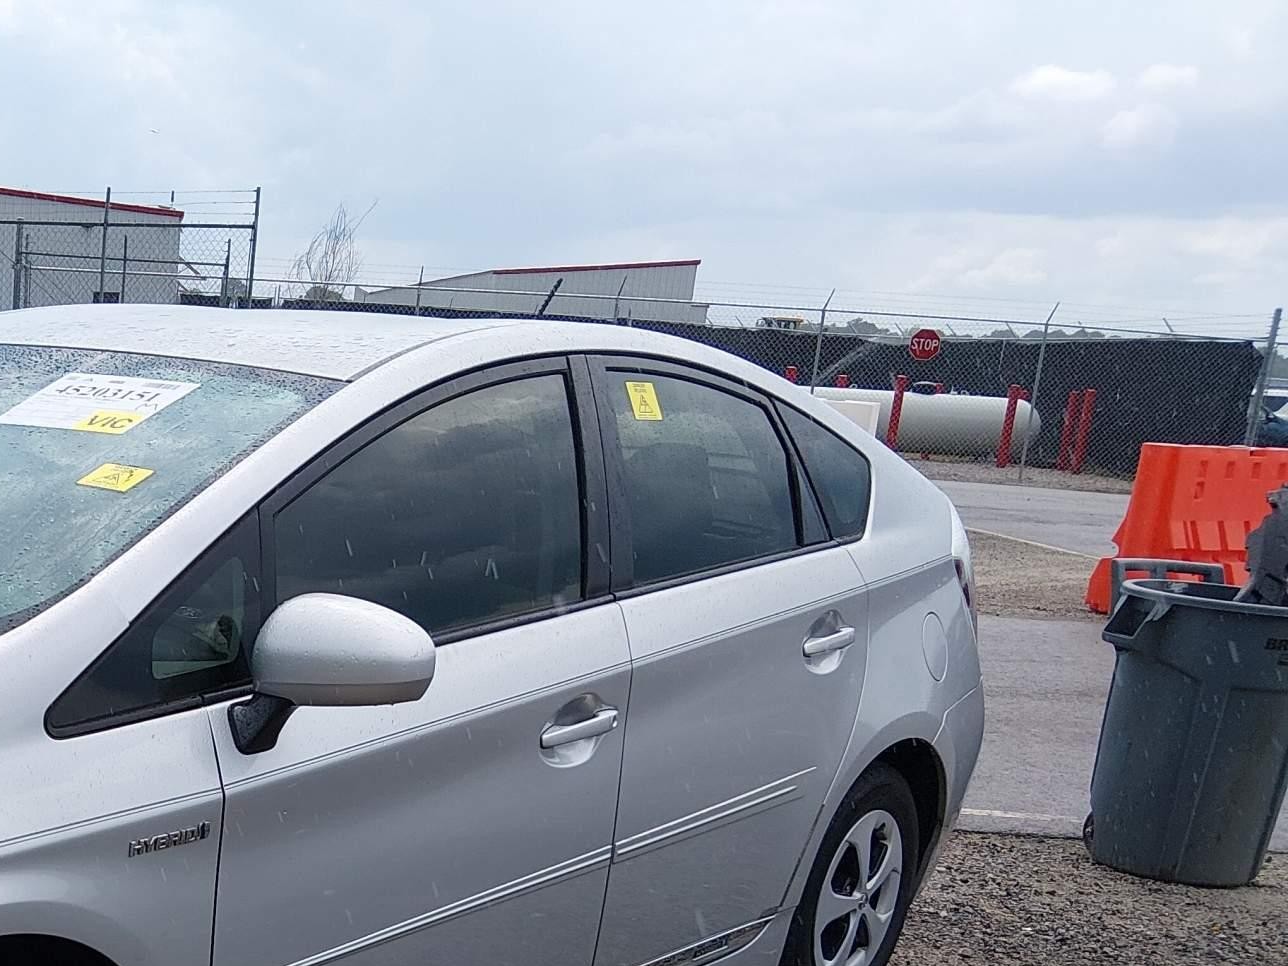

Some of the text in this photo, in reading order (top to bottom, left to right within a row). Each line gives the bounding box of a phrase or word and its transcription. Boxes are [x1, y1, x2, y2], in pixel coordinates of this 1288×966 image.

[911, 338, 939, 351] STOP
[55, 384, 161, 402] 45203151
[86, 414, 134, 430] VIC
[128, 826, 199, 857] HYBRID
